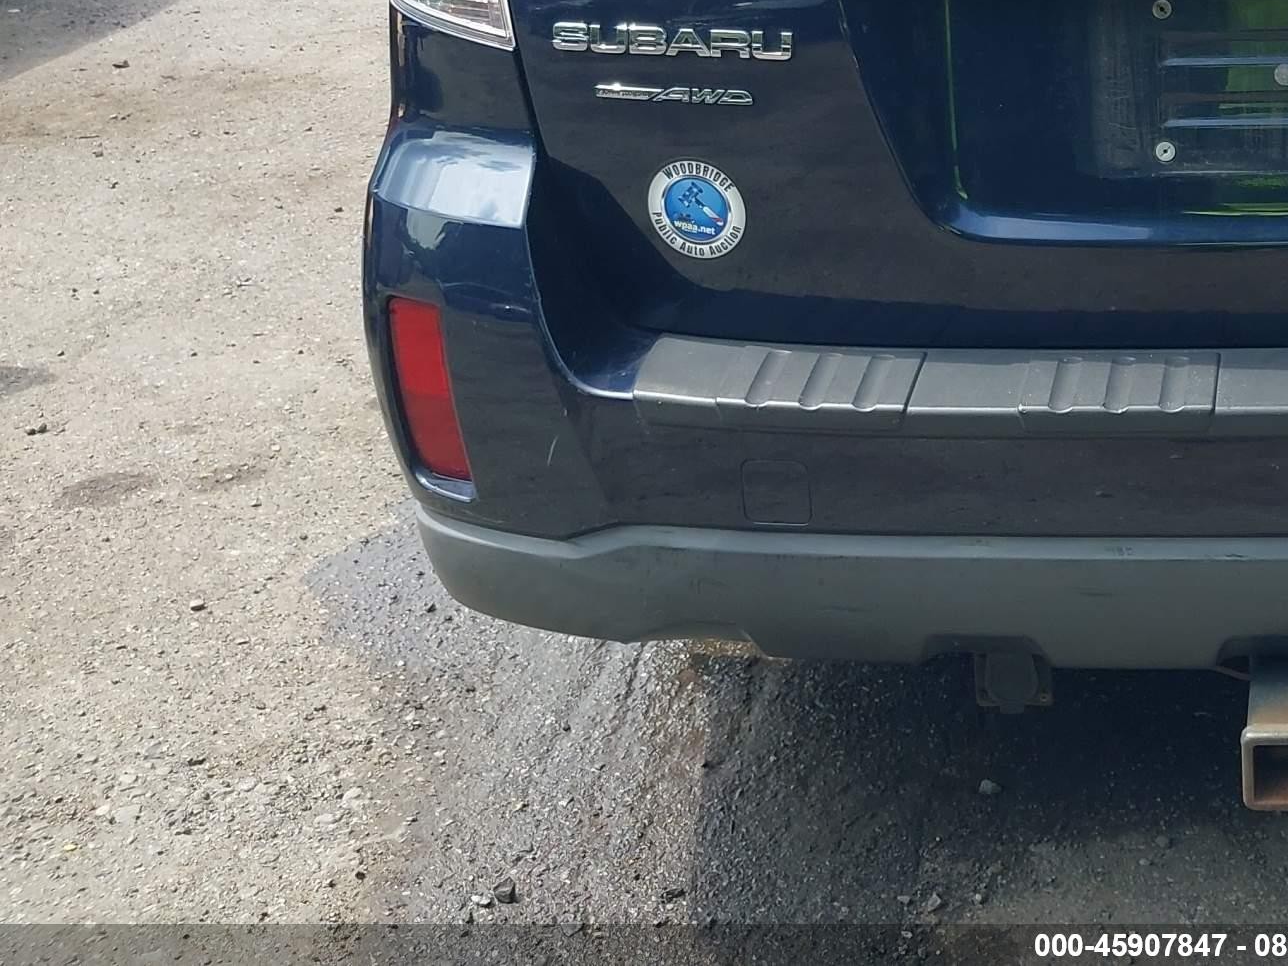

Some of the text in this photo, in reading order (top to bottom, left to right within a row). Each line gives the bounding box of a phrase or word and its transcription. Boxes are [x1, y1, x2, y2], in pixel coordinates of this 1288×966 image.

[552, 21, 793, 61] SUBARU
[652, 86, 754, 106] AWD
[661, 162, 735, 193] WOODBRIDGE
[673, 219, 716, 236] wpaa.net
[680, 241, 705, 257] Auto
